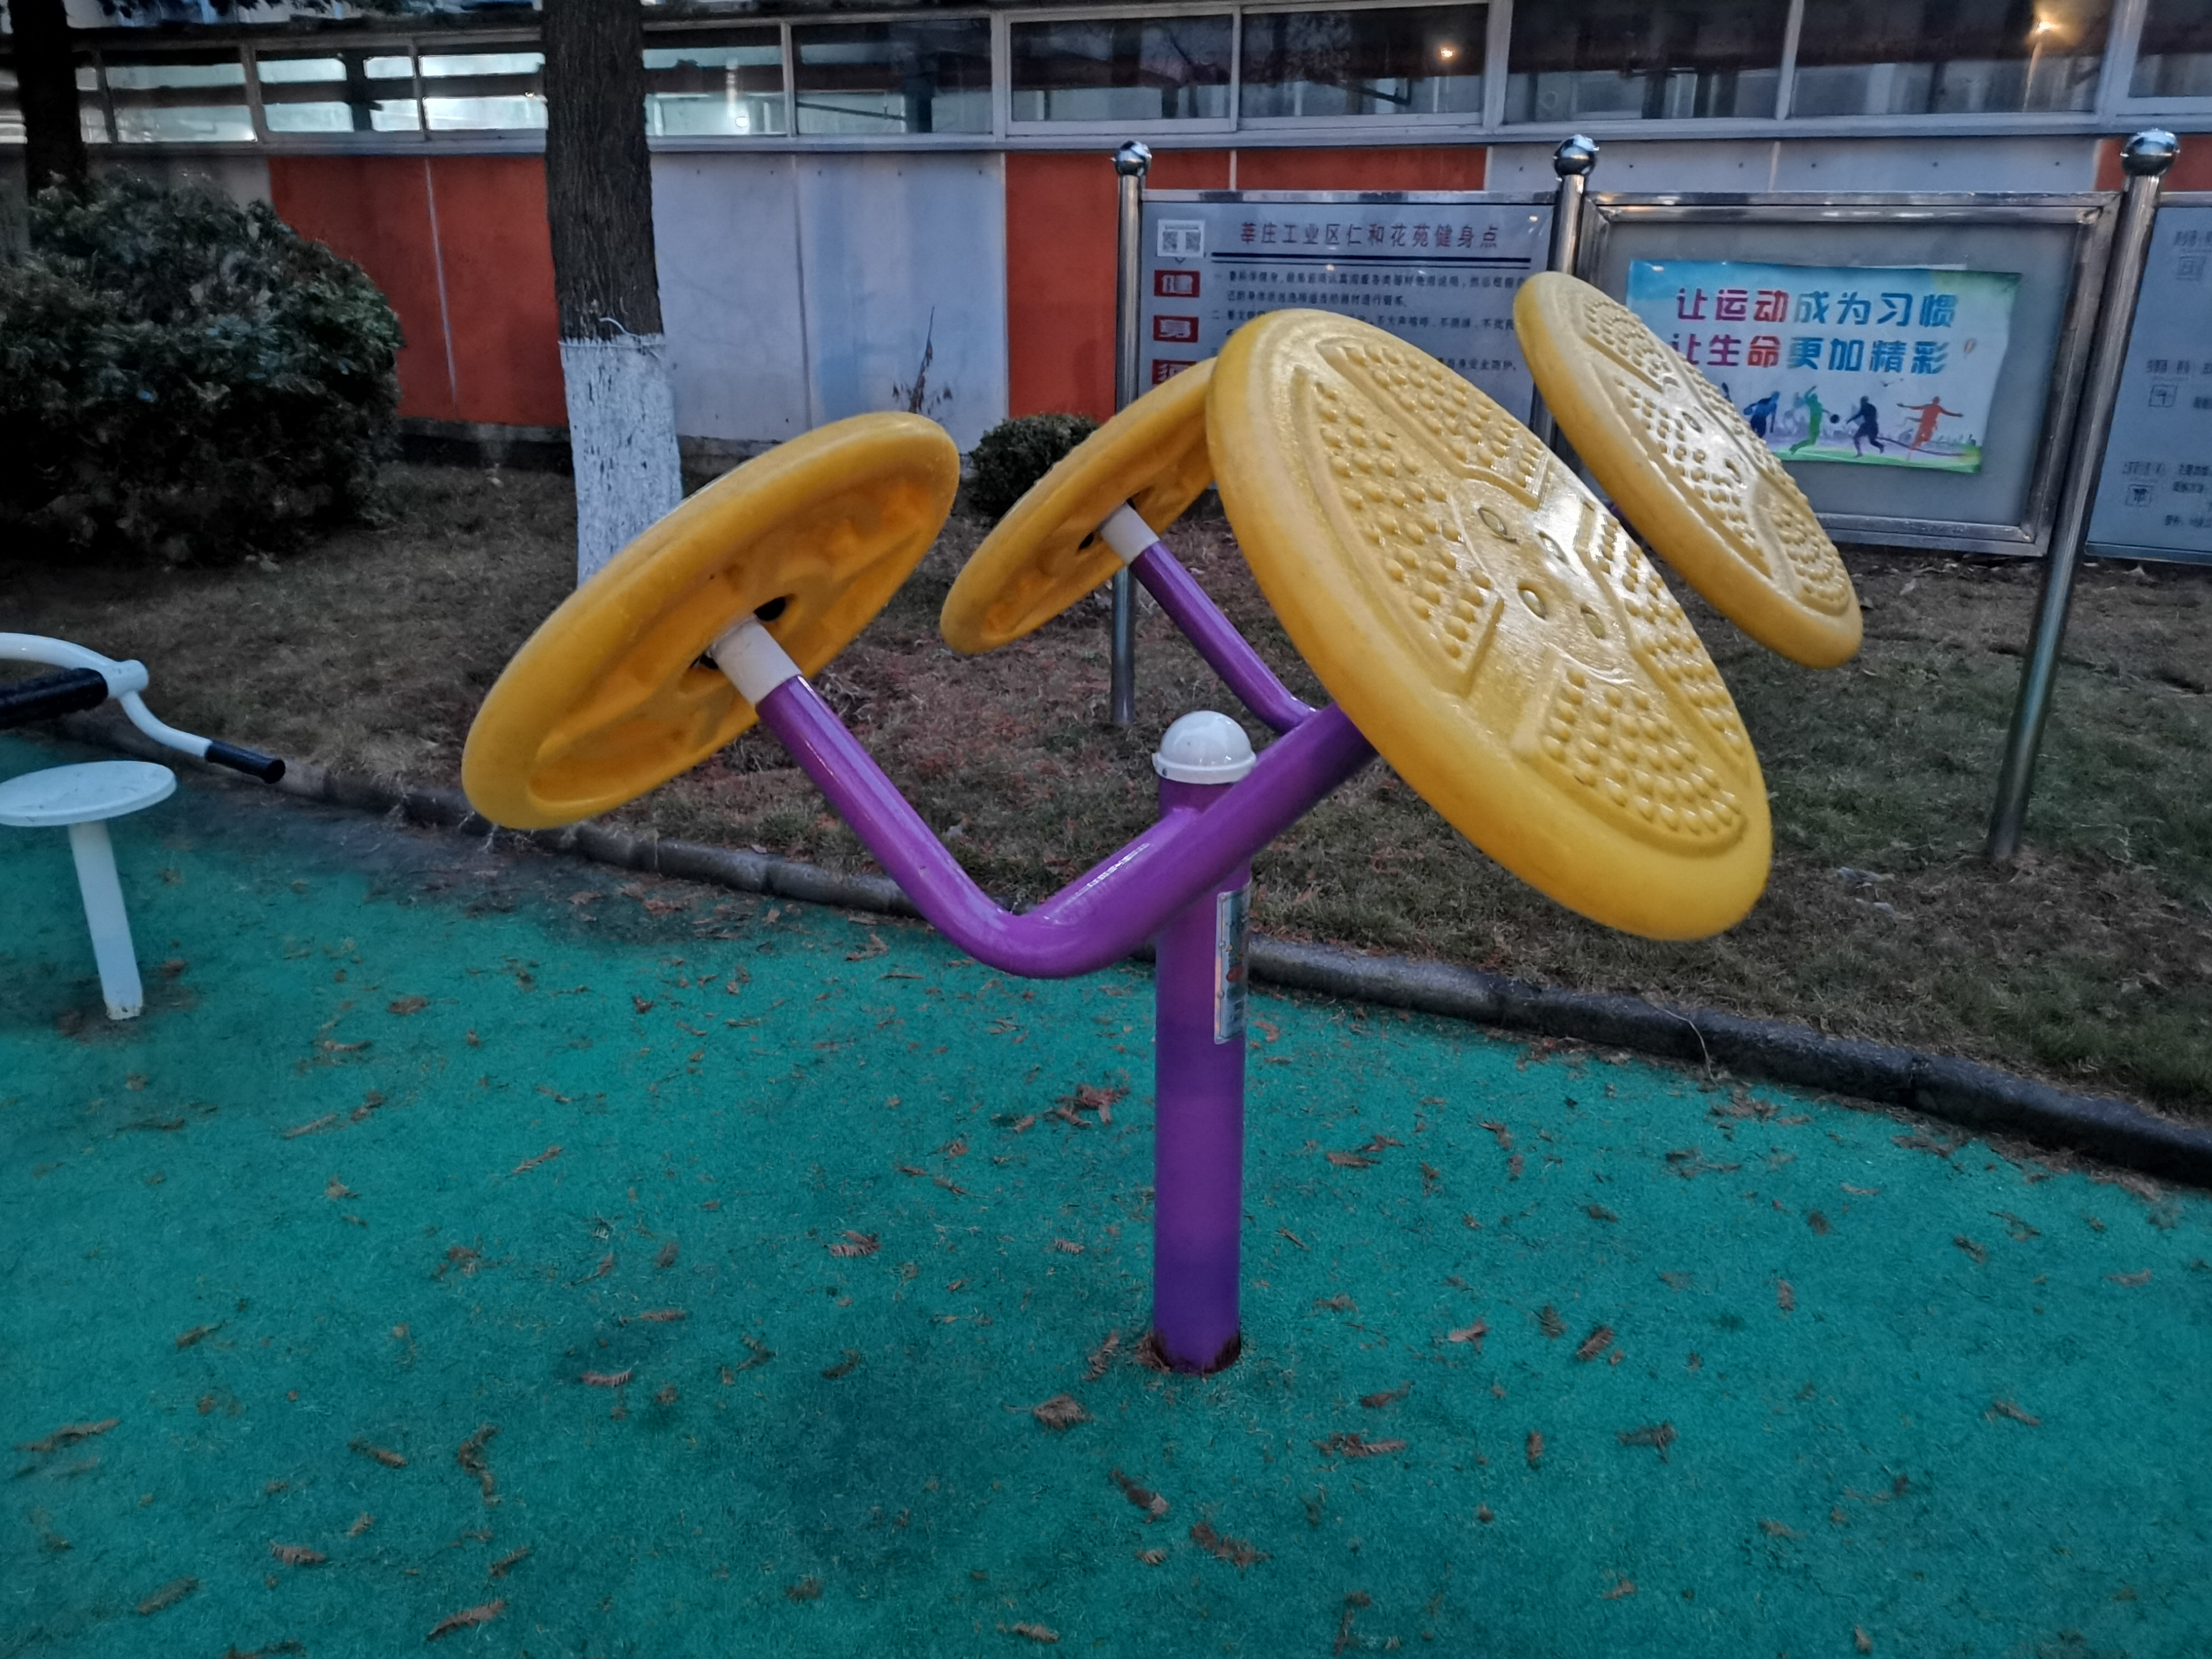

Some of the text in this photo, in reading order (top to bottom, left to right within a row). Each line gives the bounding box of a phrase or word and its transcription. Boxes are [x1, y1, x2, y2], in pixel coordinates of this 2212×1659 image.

[1240, 222, 1499, 248] 莘庄工业区仁和花苑健身点
[1677, 287, 1958, 328] 让运动成为习惯
[1670, 333, 1950, 375] 让生命更加精彩
